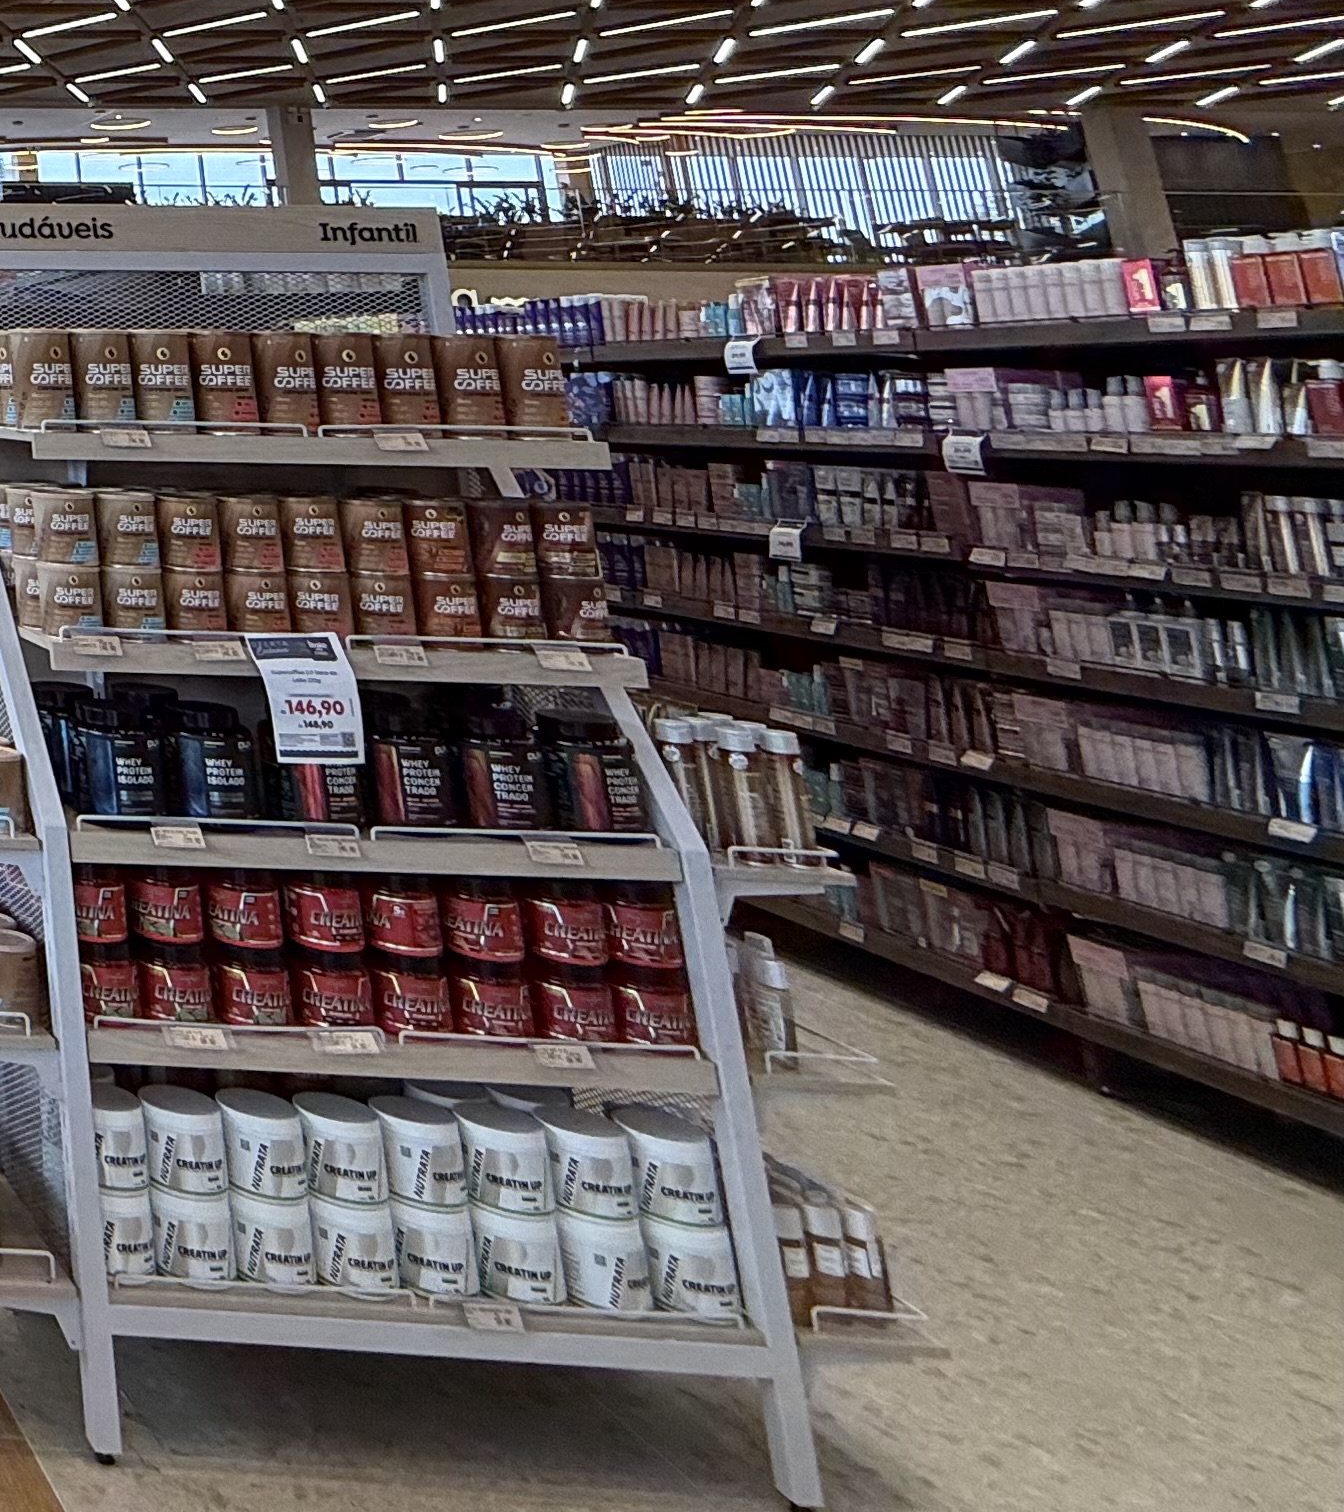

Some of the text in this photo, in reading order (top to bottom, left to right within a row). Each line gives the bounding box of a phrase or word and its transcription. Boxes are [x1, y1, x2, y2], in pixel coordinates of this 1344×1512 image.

[319, 222, 419, 245] Infantil
[285, 699, 345, 719] 146,90
[251, 1143, 269, 1191] NUTRATA
[413, 1149, 431, 1199] NUTRATA
[561, 1156, 580, 1206] NUTRATA
[642, 1161, 659, 1210] NUTRATA
[247, 1228, 264, 1276] NUTRATA
[330, 1233, 347, 1282] NUTRATA
[608, 1256, 625, 1309] NUTRATA
[661, 1254, 680, 1304] NUTRATA
